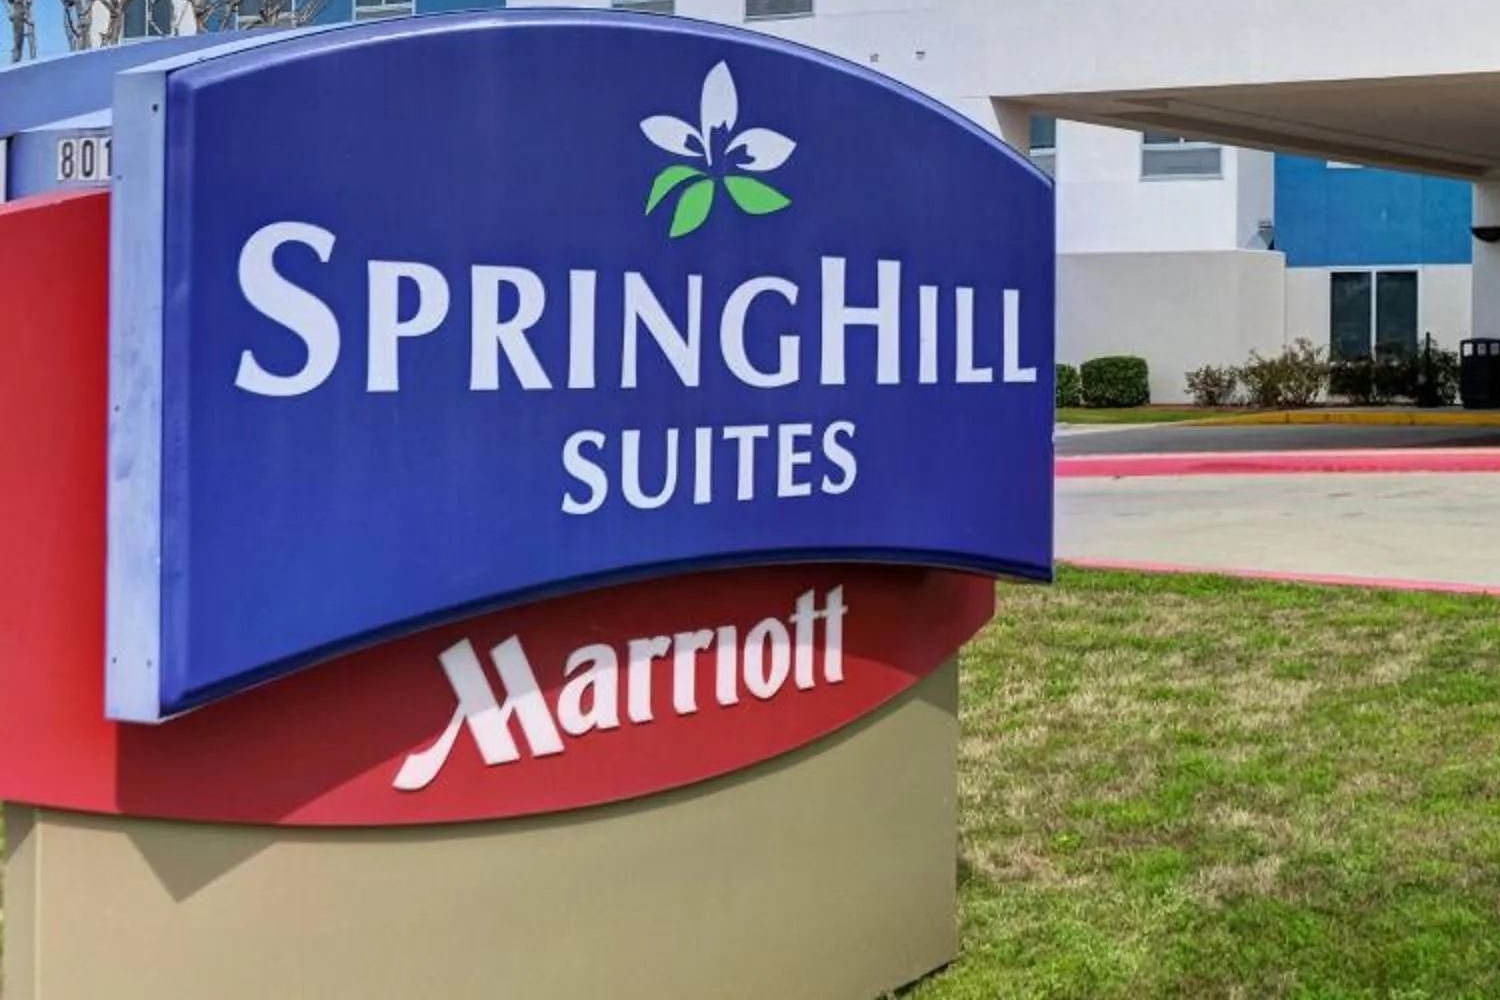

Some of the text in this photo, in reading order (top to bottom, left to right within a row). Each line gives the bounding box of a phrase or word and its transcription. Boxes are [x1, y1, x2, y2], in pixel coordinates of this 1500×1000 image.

[234, 221, 1037, 397] SPRINGHILL
[560, 420, 858, 515] SUITES
[392, 585, 849, 791] Marriott
